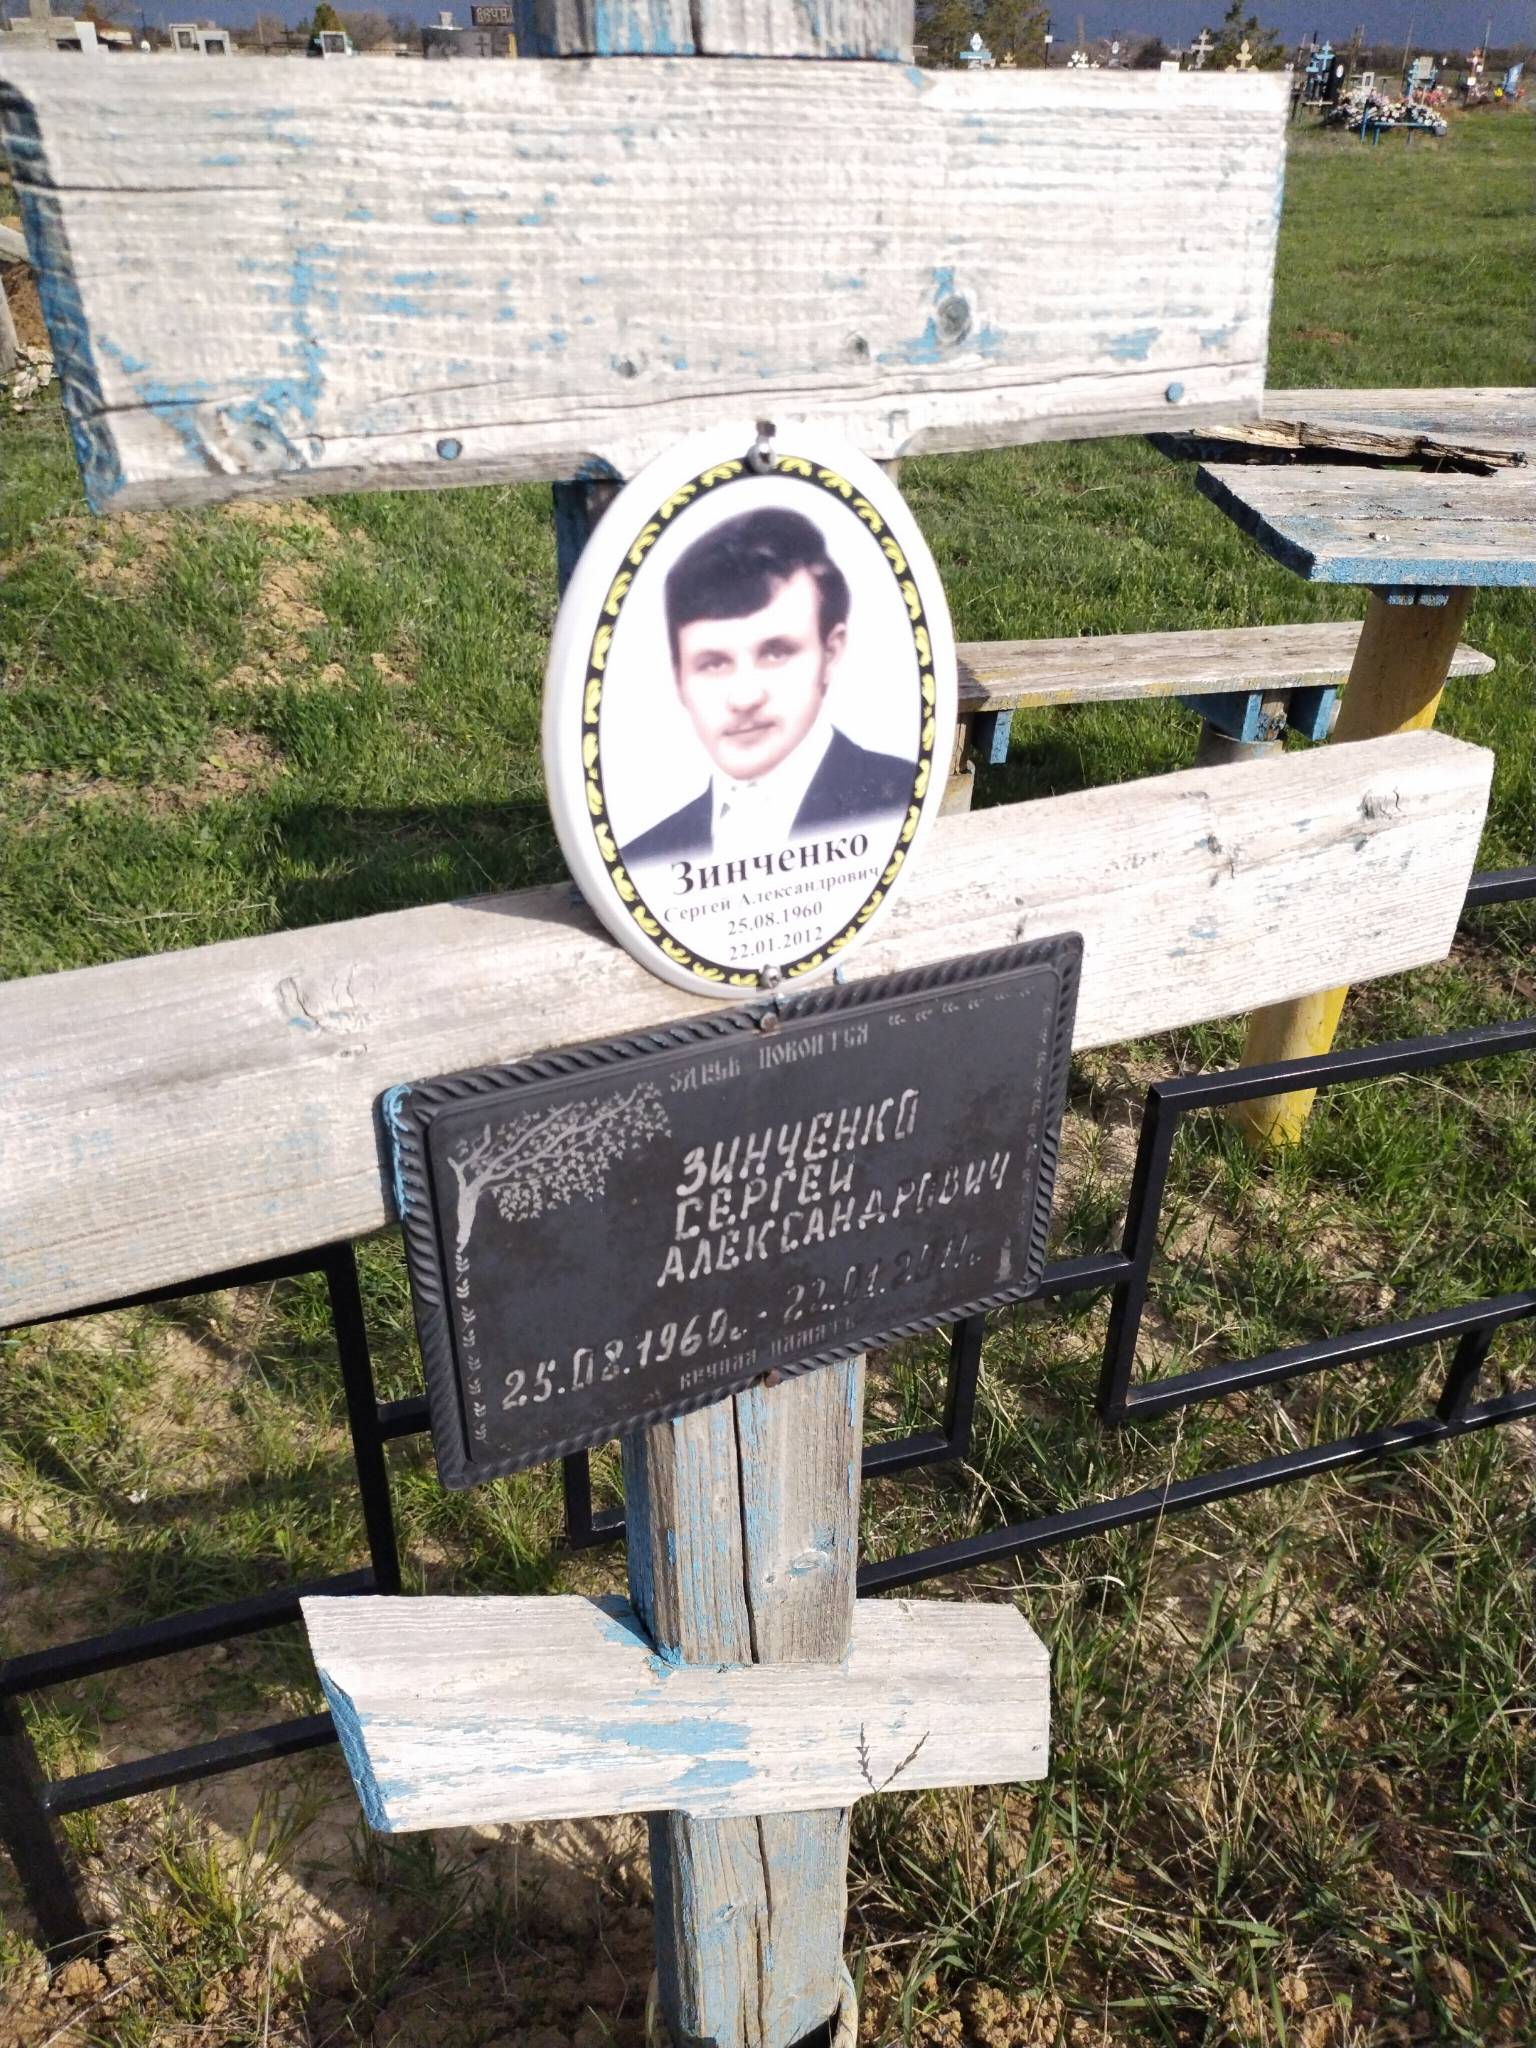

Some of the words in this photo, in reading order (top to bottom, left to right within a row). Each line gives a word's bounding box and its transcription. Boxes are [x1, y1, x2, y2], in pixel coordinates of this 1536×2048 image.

[671, 833, 868, 896] Зинченко
[663, 899, 731, 923] Сергей
[740, 866, 880, 907] Александрович
[727, 901, 823, 936] 25.08.1960
[728, 926, 824, 961] 22.01.2012
[676, 1088, 919, 1197] ЗИНЧЕНКО
